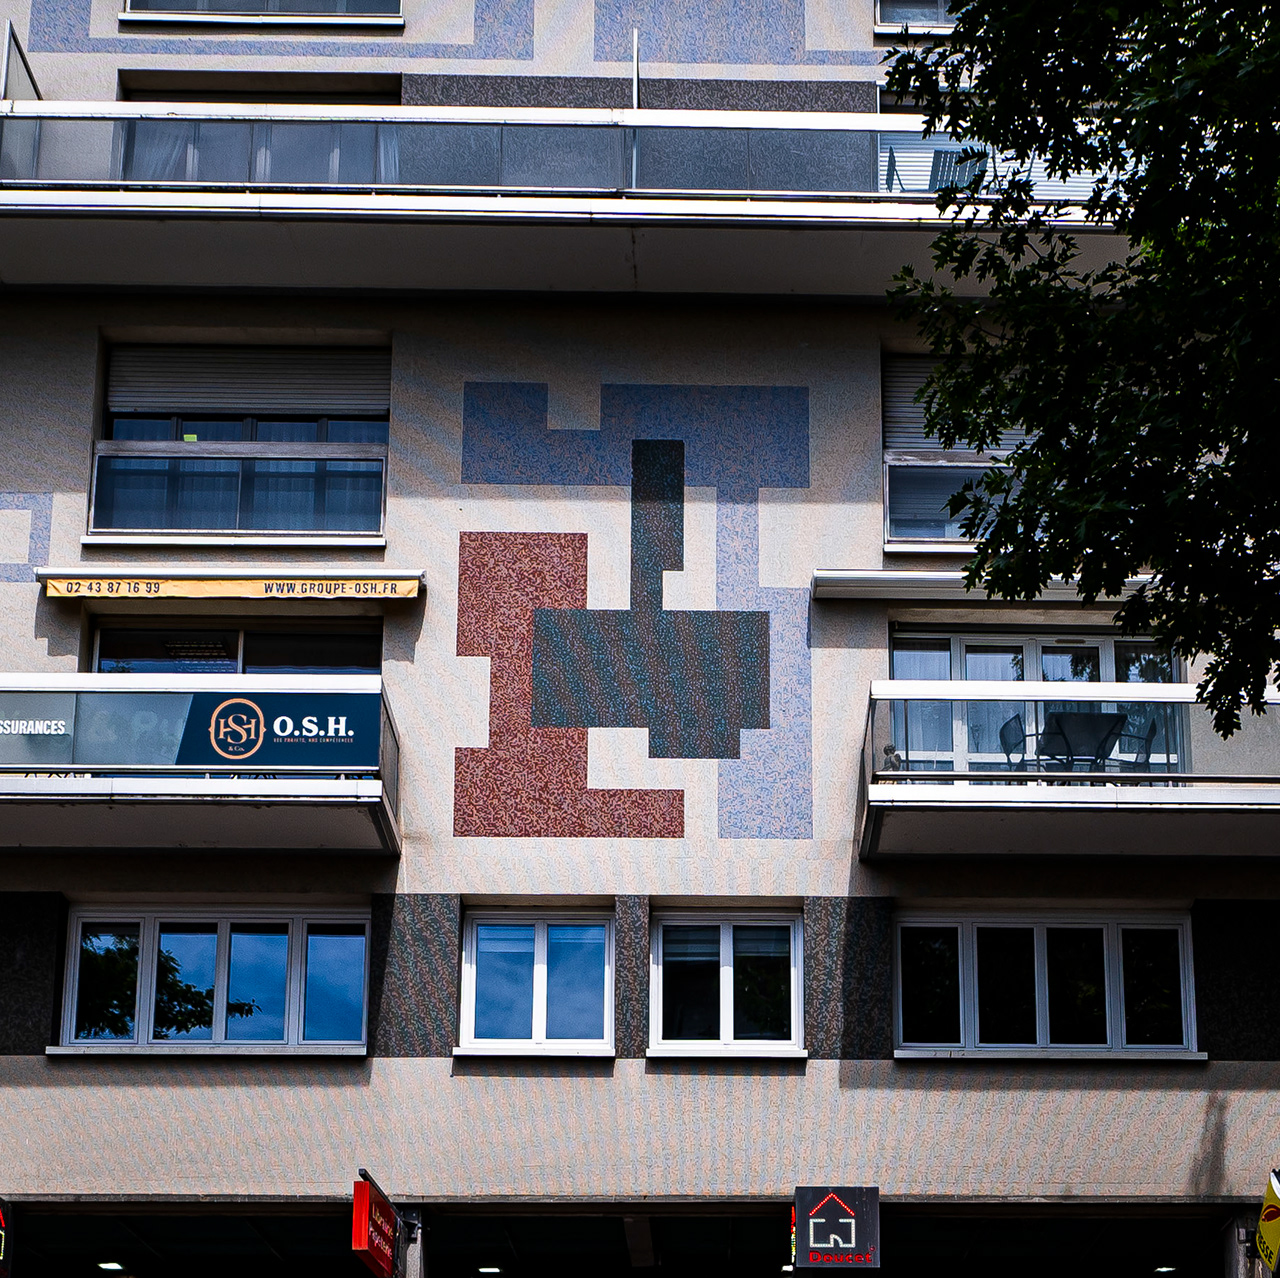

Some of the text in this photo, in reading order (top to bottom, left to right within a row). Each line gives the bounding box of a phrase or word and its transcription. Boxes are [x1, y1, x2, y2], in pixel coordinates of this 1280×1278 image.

[67, 581, 161, 593] 02 43 87 16 99
[264, 581, 398, 595] WWW.GROUPE-OSH.FR
[273, 715, 355, 736] O.S.H.
[809, 1250, 873, 1263] Doucet
